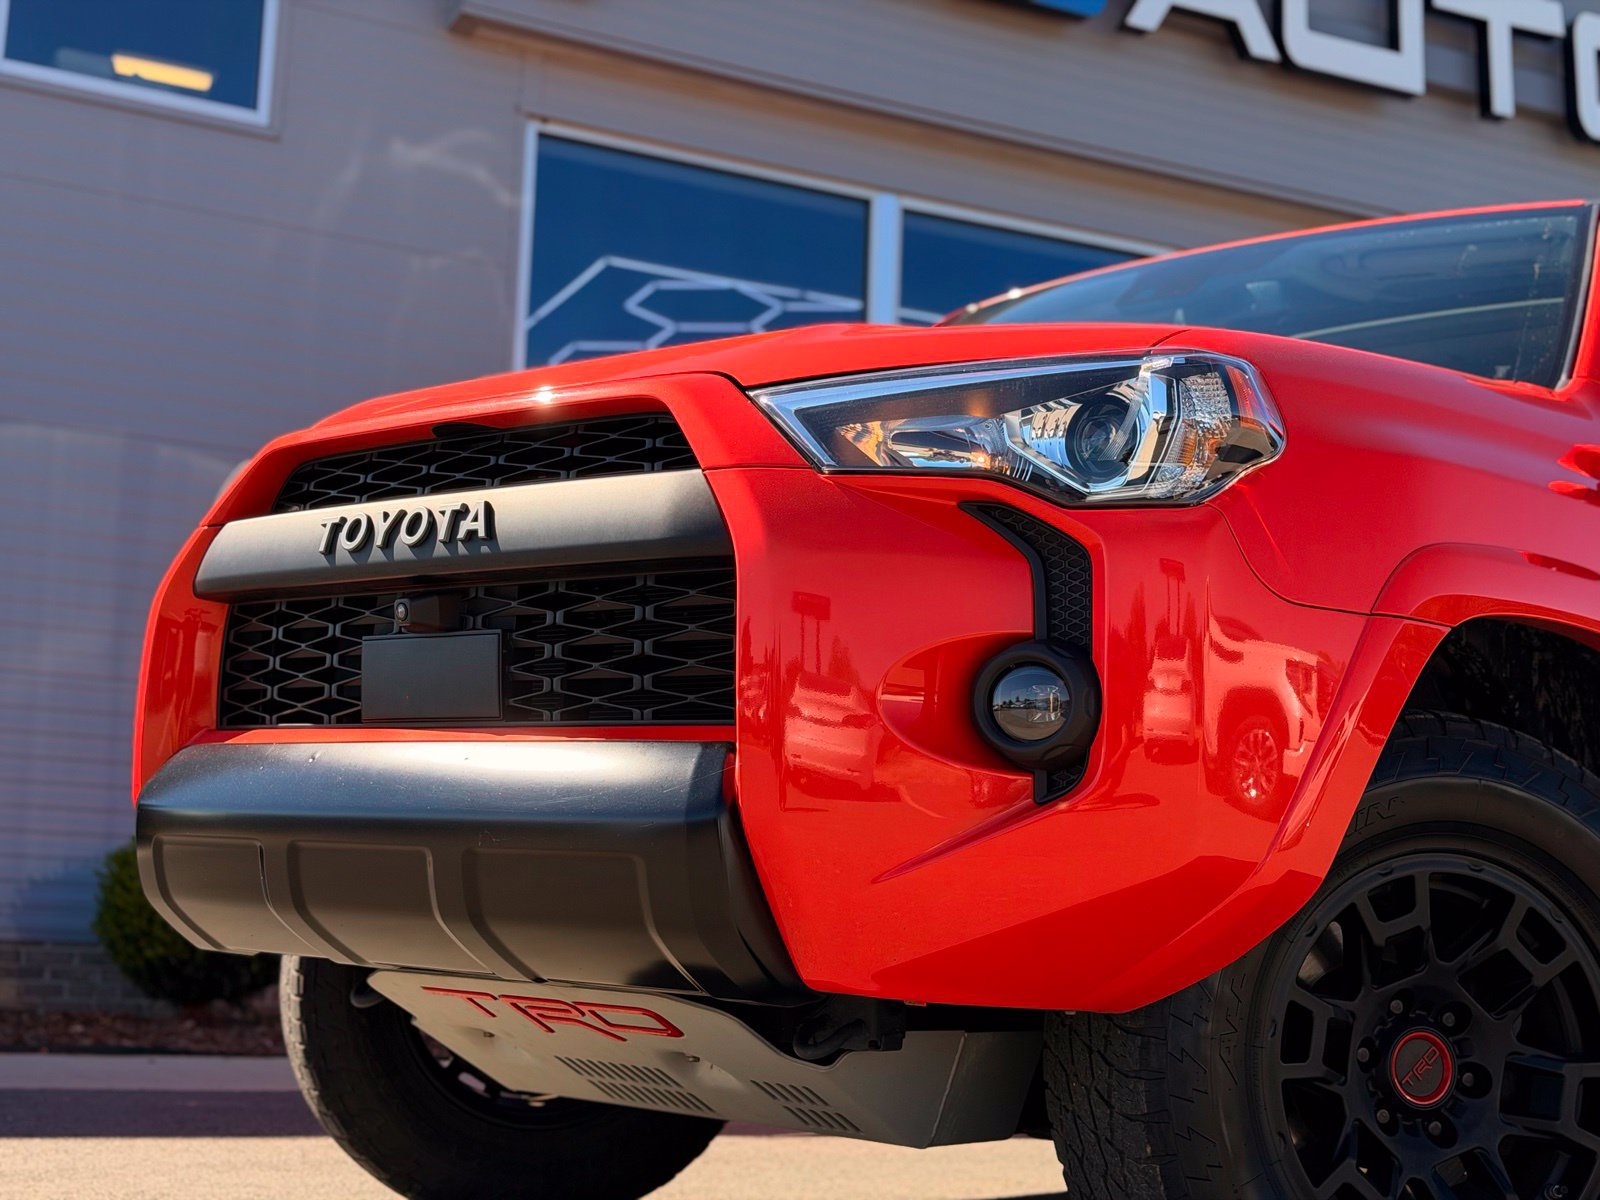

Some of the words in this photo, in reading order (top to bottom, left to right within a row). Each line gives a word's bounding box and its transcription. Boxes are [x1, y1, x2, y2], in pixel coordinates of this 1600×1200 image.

[319, 501, 494, 555] TOYOTA
[421, 986, 684, 1042] TRD
[1402, 1046, 1440, 1088] TRD
